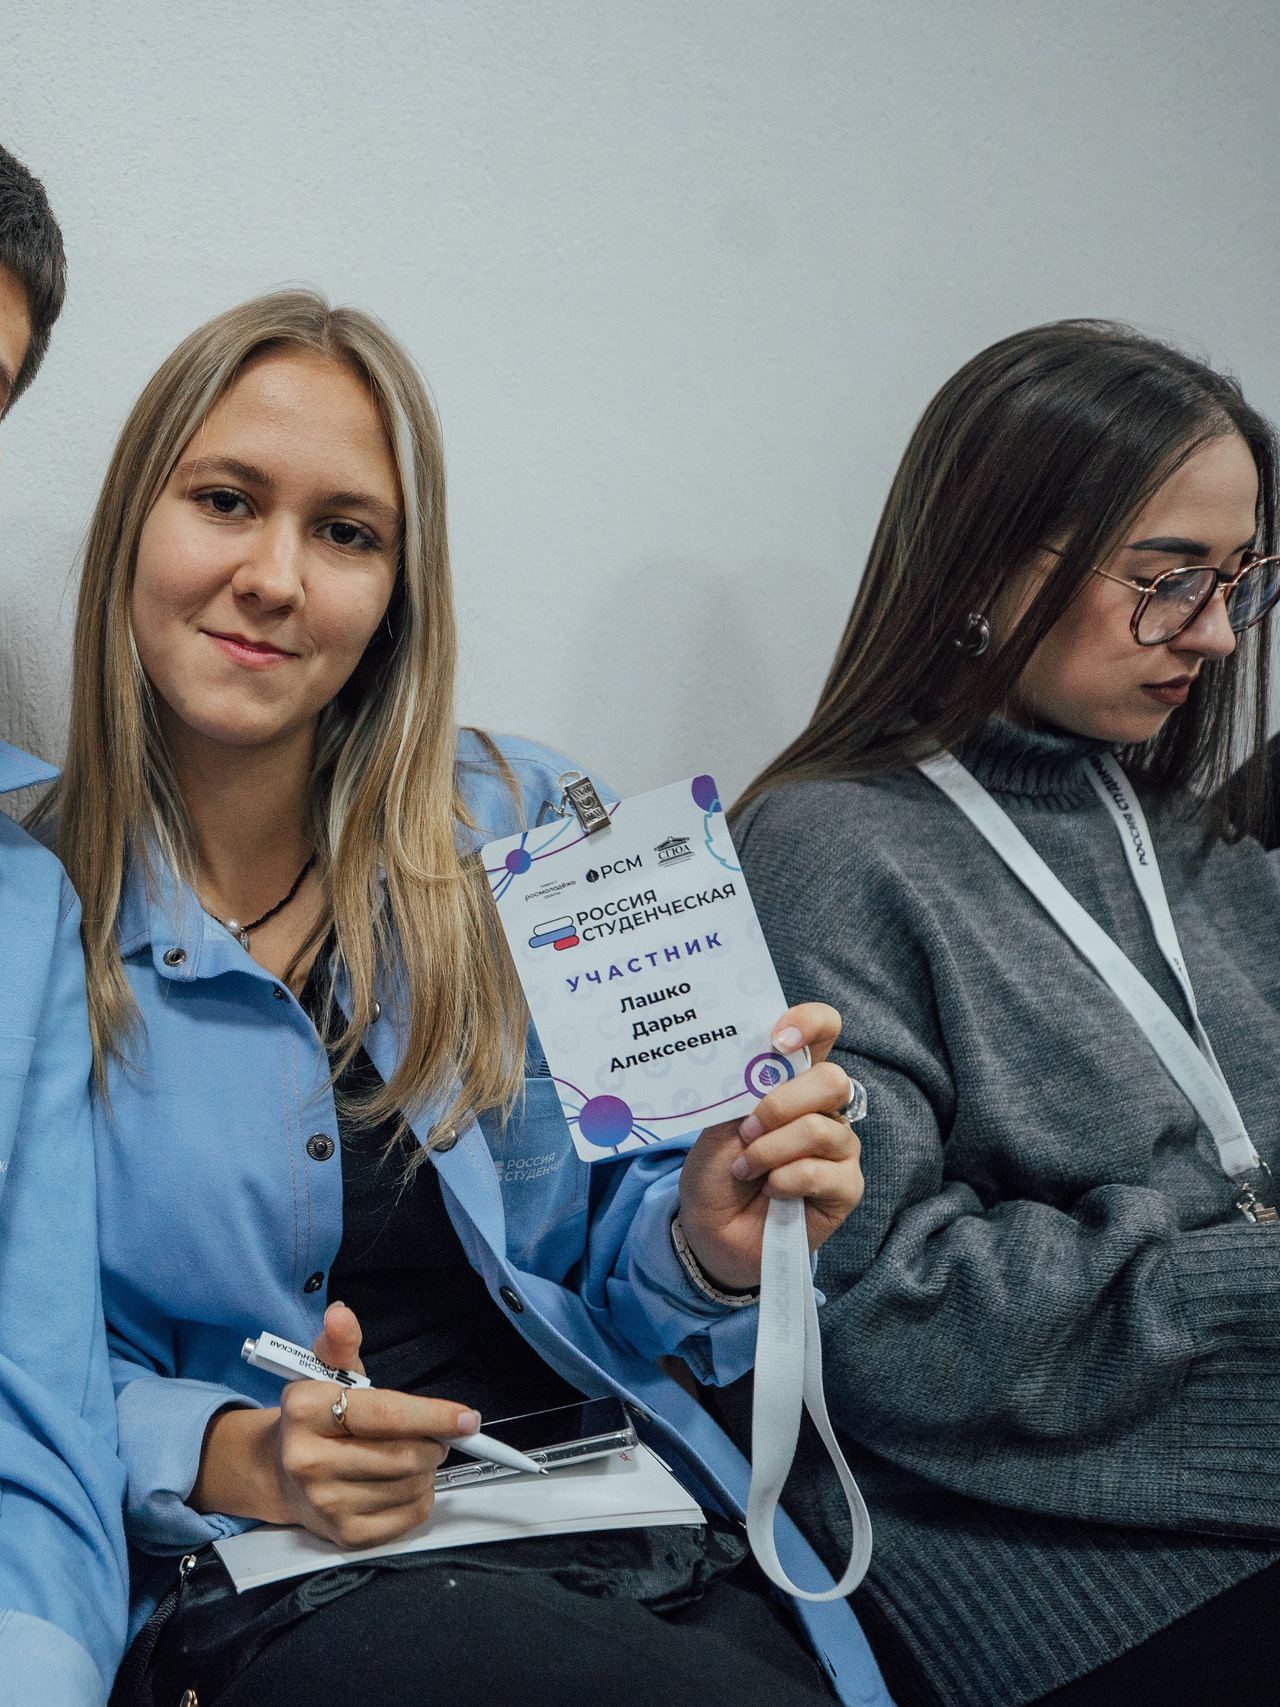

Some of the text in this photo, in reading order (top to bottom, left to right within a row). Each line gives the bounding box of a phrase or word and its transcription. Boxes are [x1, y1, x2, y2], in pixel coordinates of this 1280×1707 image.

[600, 854, 643, 879] РСМ
[576, 889, 658, 926] РОССИЯ
[582, 883, 737, 942] СТУДЕНЧЕСКАЯ
[565, 932, 722, 992] УЧАСТНИК
[620, 982, 691, 1013] Лашко
[632, 1008, 697, 1040] Дарья
[610, 1024, 738, 1073] Алексеевна
[507, 1152, 556, 1169] РОССИЯ
[299, 1359, 335, 1379] РОССИЯ
